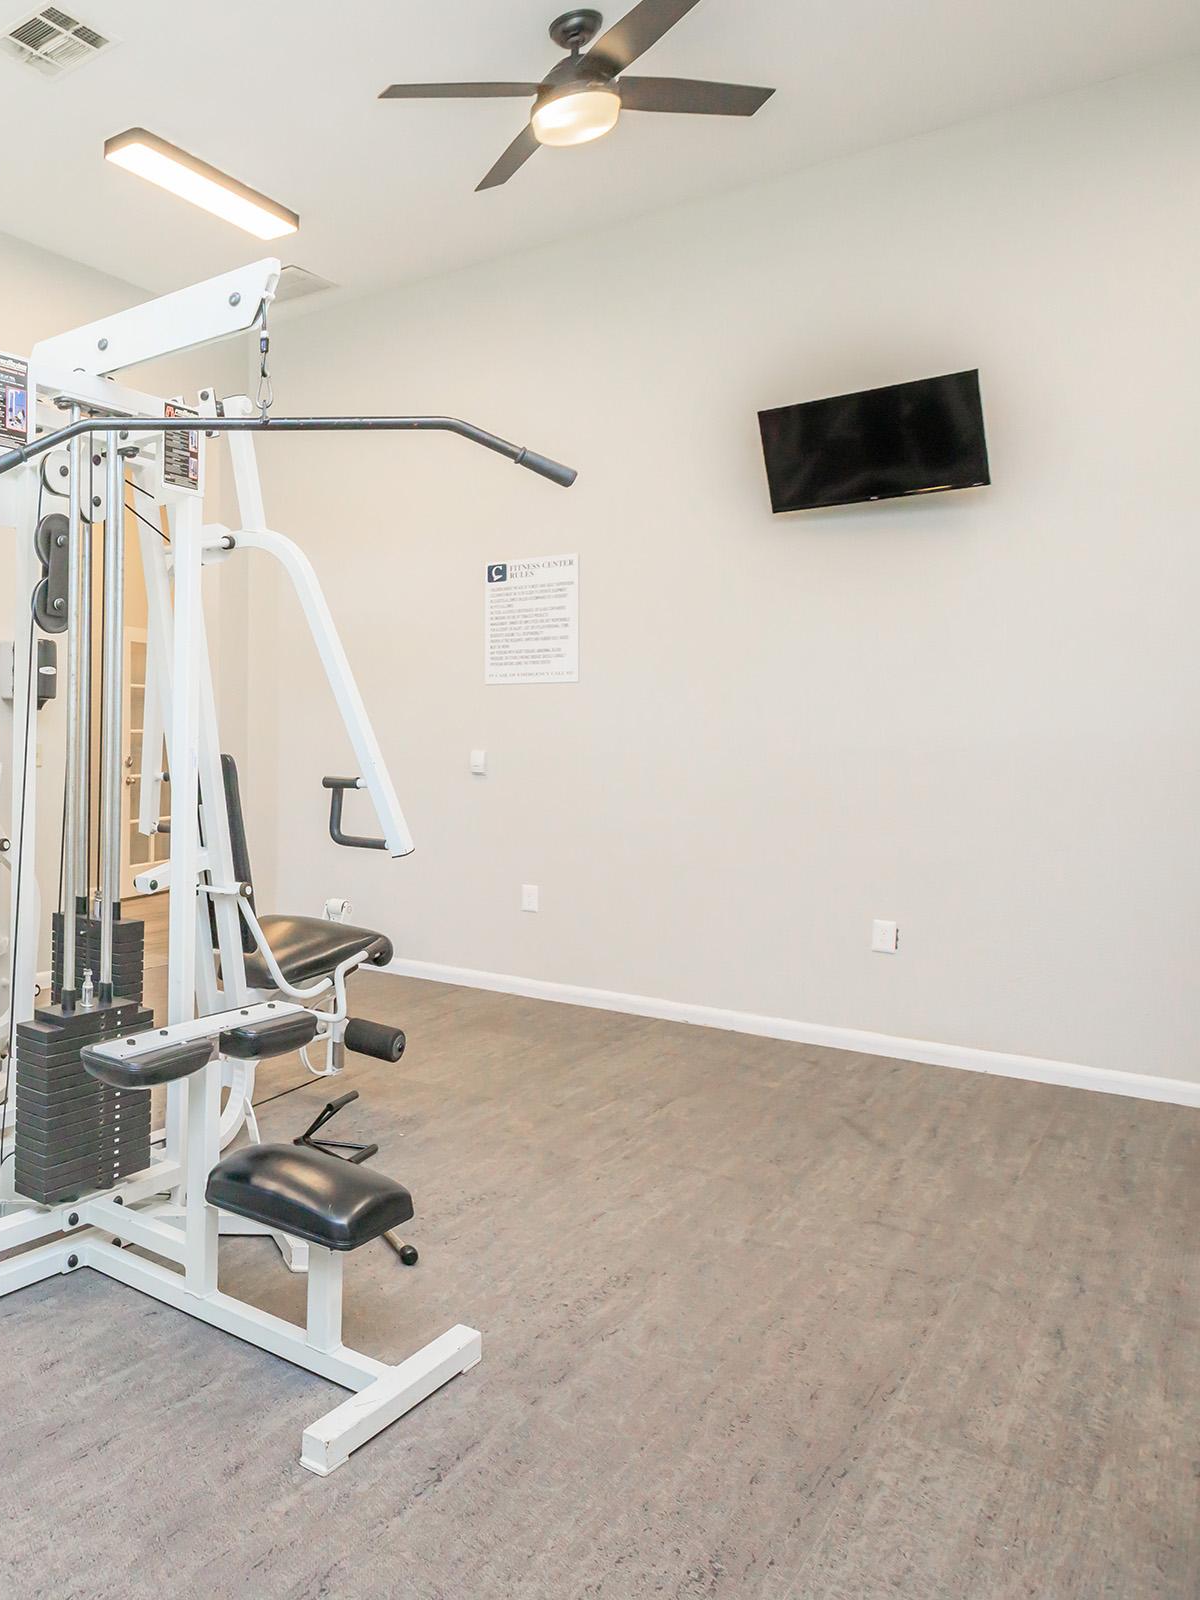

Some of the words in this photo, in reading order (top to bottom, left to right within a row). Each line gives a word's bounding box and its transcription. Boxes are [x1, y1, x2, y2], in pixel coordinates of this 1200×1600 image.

[509, 562, 541, 572] FITNESS
[541, 559, 574, 569] CENTER
[509, 571, 535, 579] RULES
